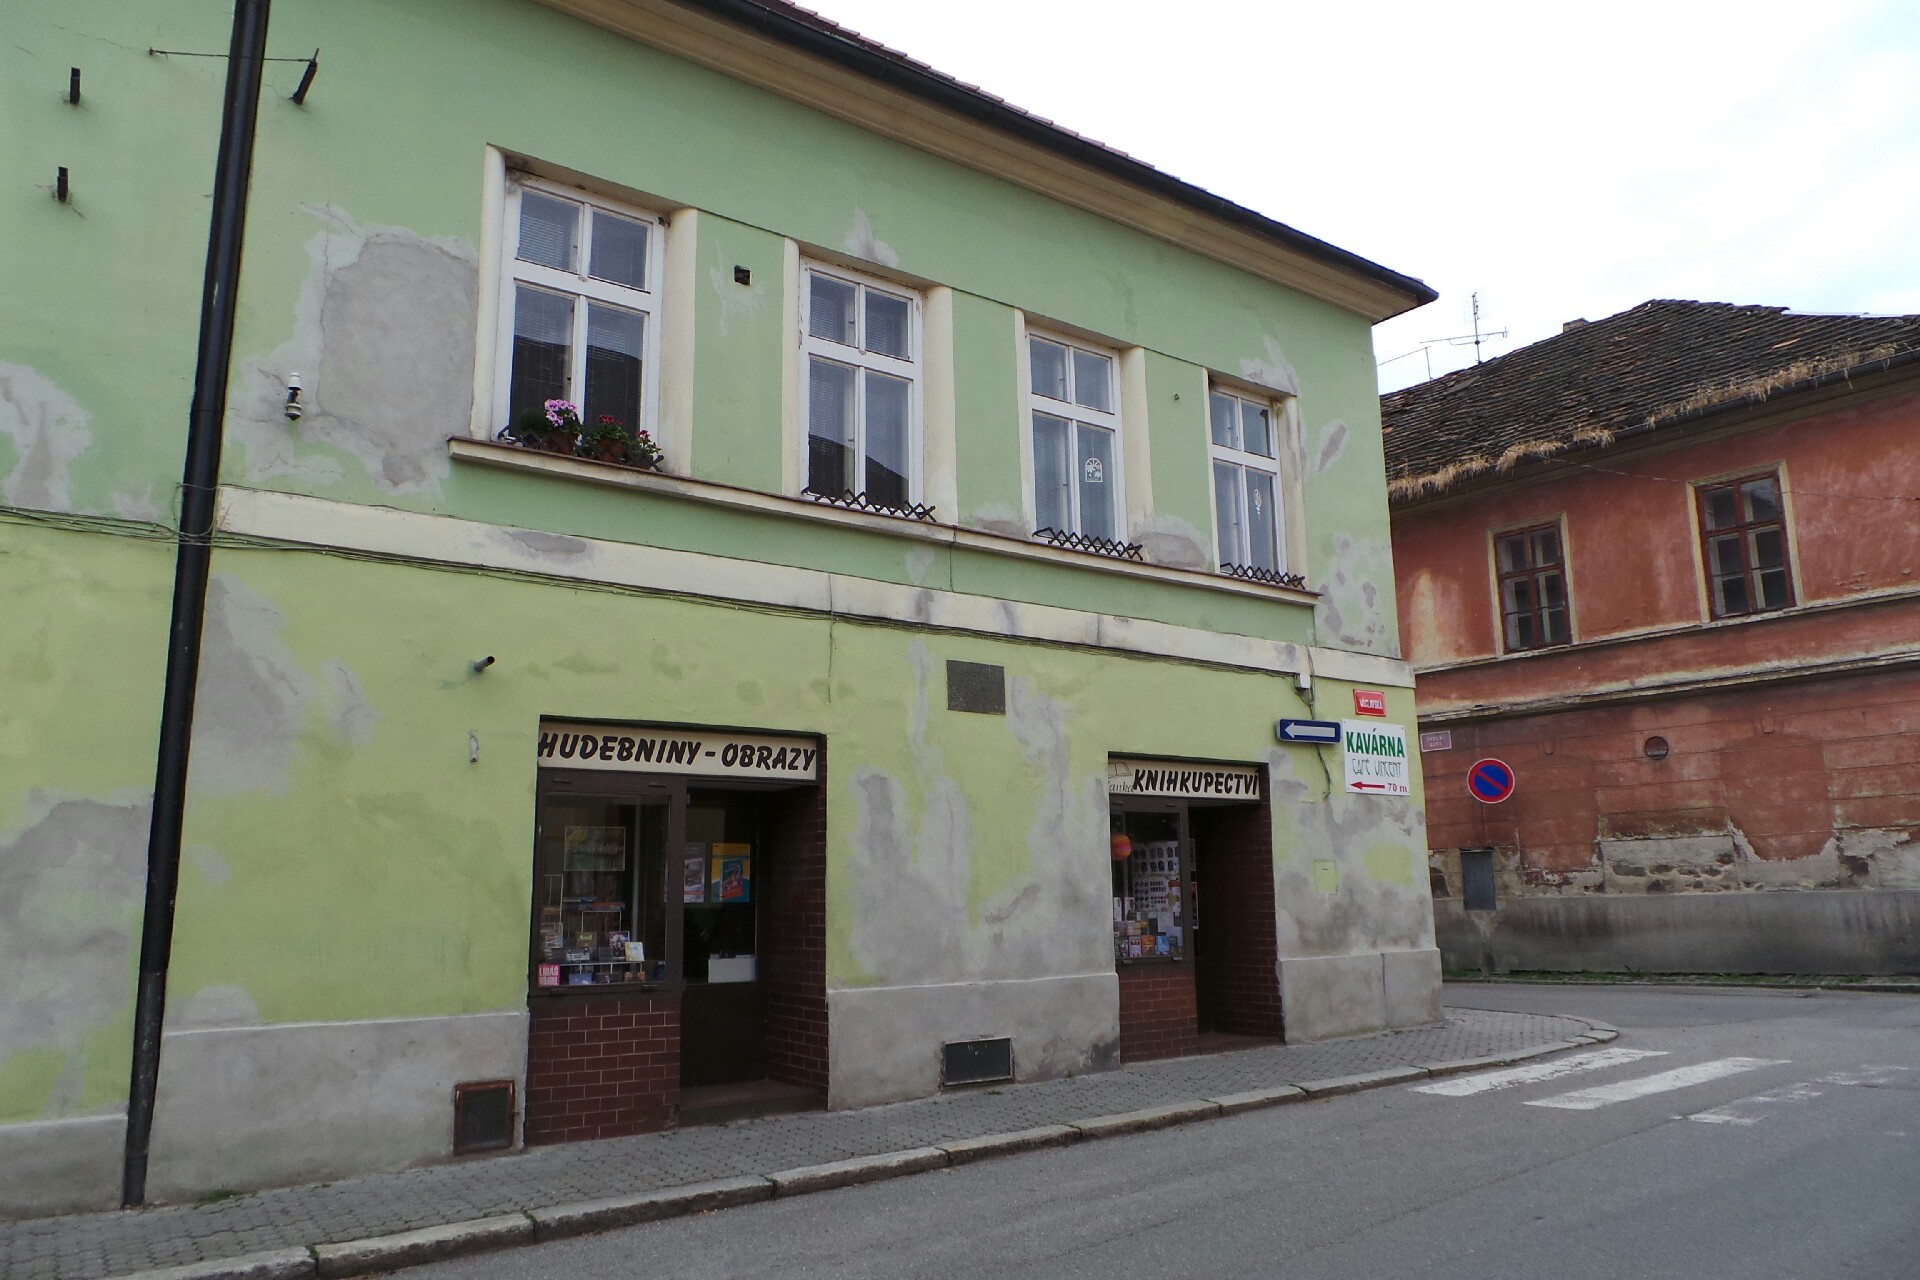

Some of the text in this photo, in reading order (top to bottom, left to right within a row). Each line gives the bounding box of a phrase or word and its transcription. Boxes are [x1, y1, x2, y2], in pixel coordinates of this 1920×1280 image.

[538, 733, 702, 766] HUDEBNINY
[721, 743, 816, 771] OBRAZY
[1346, 728, 1405, 758] KAVÁRNA
[1133, 768, 1260, 795] KNIHKUPECTVÍ
[1374, 760, 1402, 778] VINCENT
[1387, 783, 1397, 792] 70
